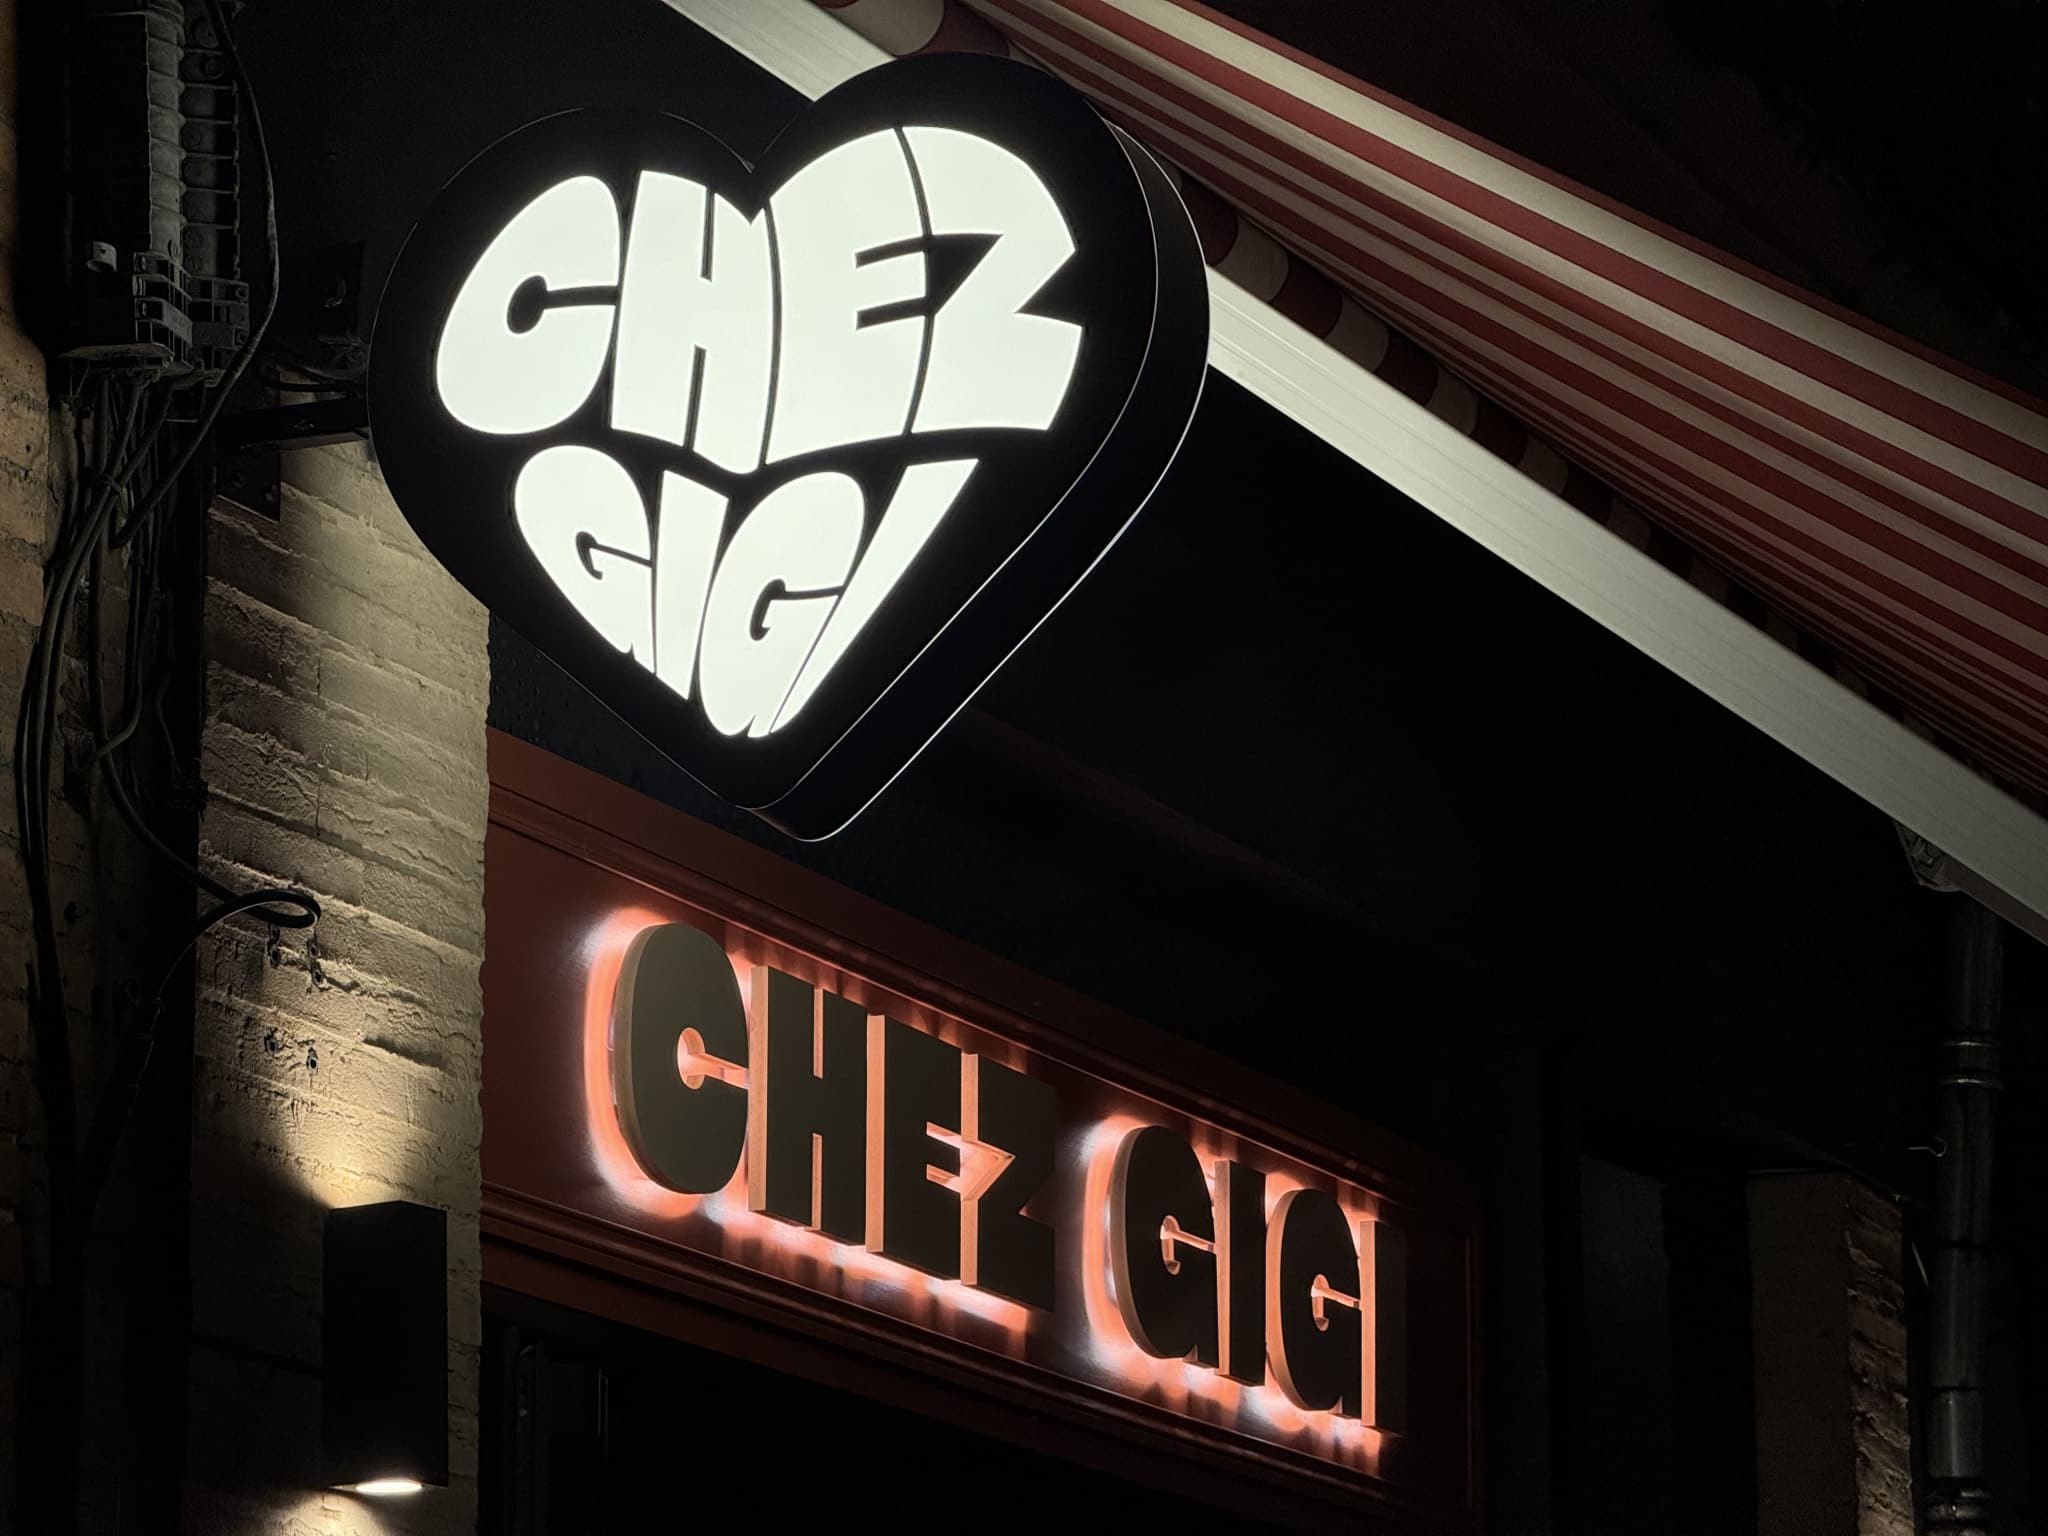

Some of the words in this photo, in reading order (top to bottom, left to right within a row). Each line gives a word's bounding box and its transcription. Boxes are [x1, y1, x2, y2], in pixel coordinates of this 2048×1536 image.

[434, 124, 1084, 475] CHEZ
[513, 443, 979, 740] GIGI
[614, 921, 1057, 1313] CHEZ
[1109, 1124, 1408, 1439] GIGI
